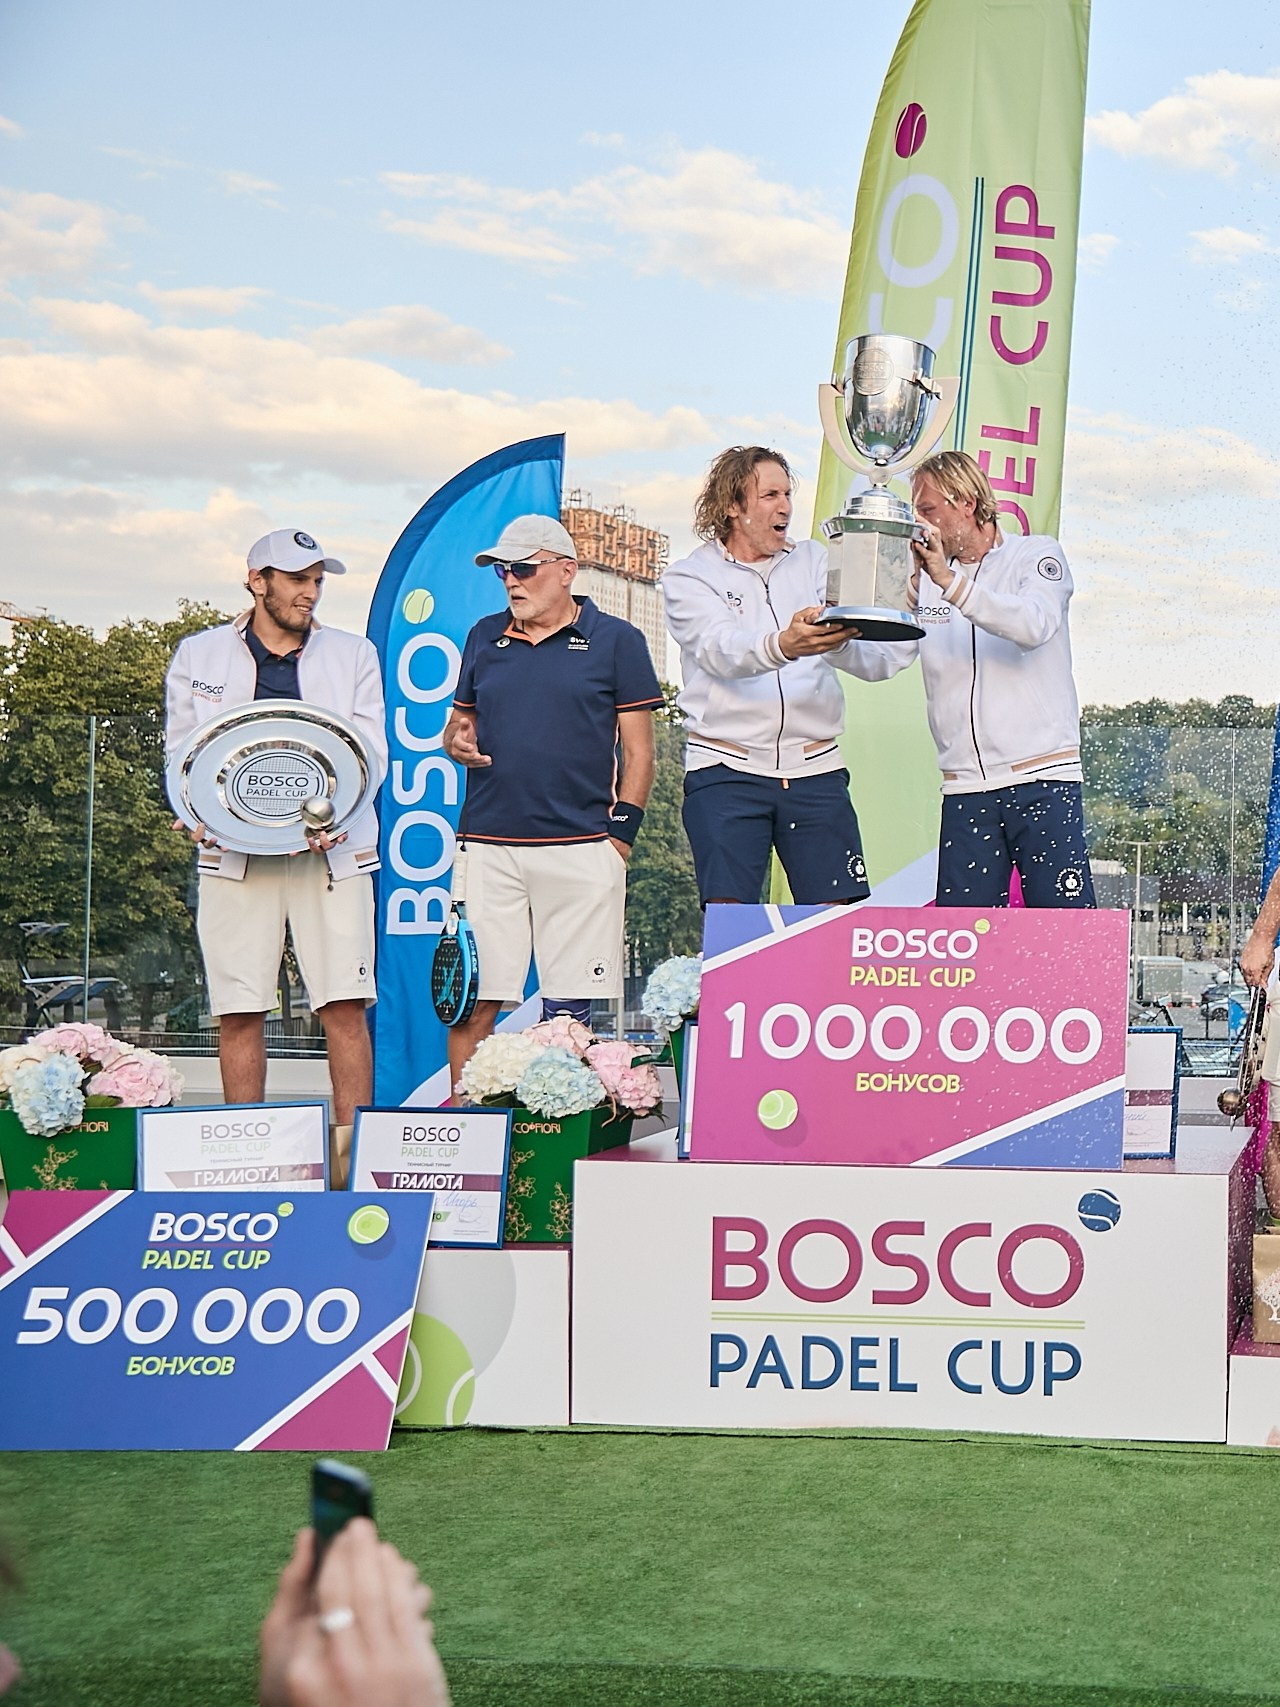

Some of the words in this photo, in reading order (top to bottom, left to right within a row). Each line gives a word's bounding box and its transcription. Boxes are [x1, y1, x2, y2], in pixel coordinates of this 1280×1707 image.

[990, 184, 1055, 366] CUP
[918, 606, 951, 615] BOSCO
[192, 680, 225, 695] BOSCO
[247, 774, 309, 788] BOSCO
[386, 632, 462, 935] BOSCO
[246, 788, 280, 798] PADEL
[285, 789, 308, 798] CUP
[851, 927, 979, 960] BOSCO
[850, 965, 922, 987] PADEL
[929, 967, 976, 988] CUP
[938, 1005, 1103, 1065] 000
[856, 1072, 960, 1093] БОНУСОВ
[201, 1121, 271, 1140] BOSCO
[402, 1126, 461, 1143] BOSCO
[201, 1142, 238, 1155] PADEL
[247, 1141, 271, 1153] CUP
[401, 1146, 433, 1158] PADEL
[438, 1146, 460, 1158] CUP
[194, 1167, 280, 1186] ГРАМОТА
[392, 1172, 464, 1190] ГРАМОТА
[148, 1212, 280, 1242] BOSCO
[142, 1249, 214, 1270] PADEL
[223, 1249, 272, 1270] CUP
[711, 1215, 1086, 1309] BOSCO
[16, 1286, 179, 1345] 500
[191, 1286, 361, 1345] 000
[126, 1355, 236, 1376] БОНУСОВ
[709, 1332, 919, 1393] PADEL
[946, 1338, 1082, 1396] CUP
